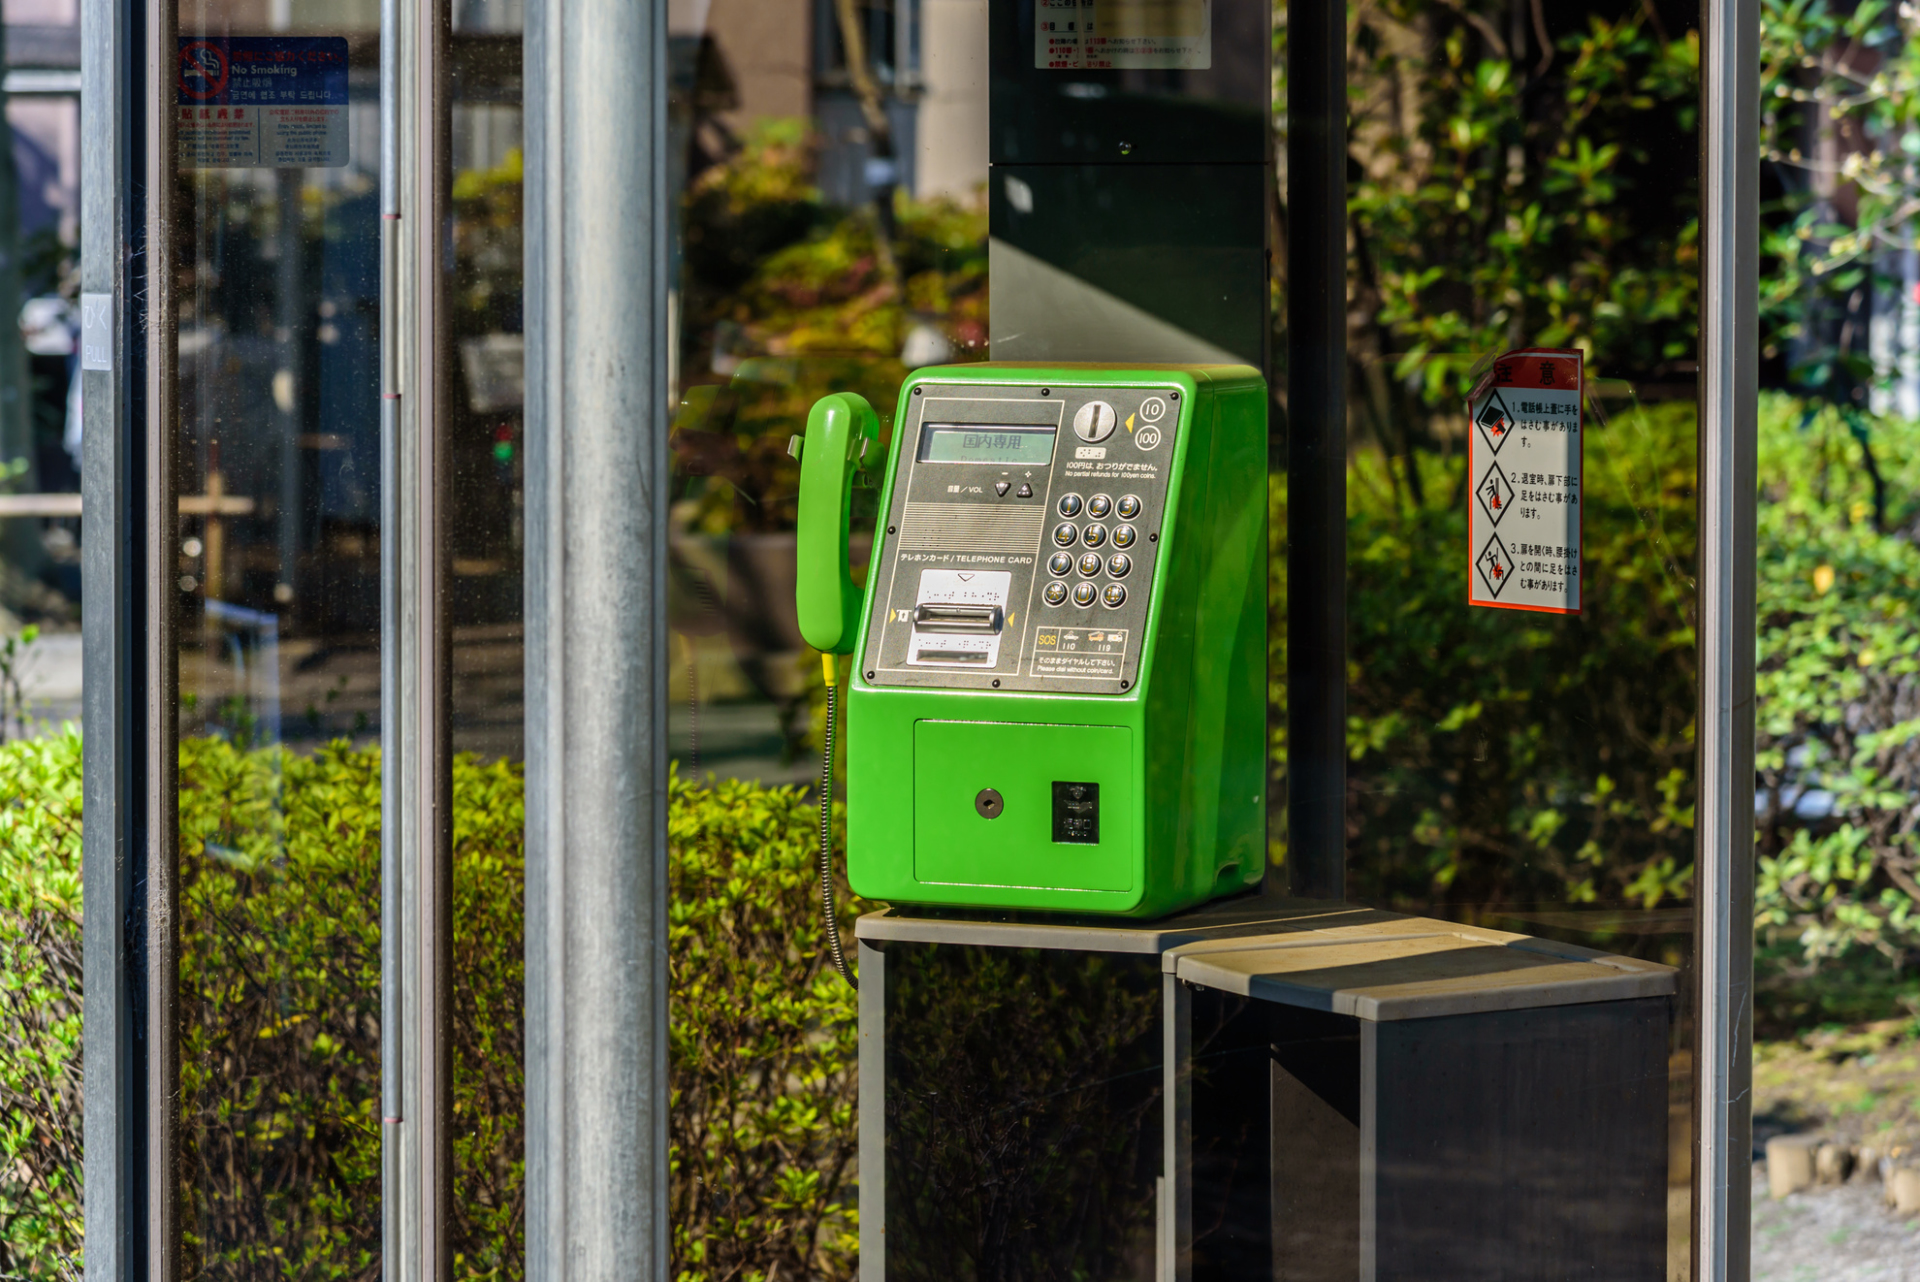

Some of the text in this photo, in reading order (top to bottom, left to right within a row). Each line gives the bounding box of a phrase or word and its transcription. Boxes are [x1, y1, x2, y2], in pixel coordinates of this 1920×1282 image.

[232, 64, 297, 77] No Smoking
[84, 305, 107, 331] ひく
[85, 345, 107, 363] PULL
[1146, 404, 1160, 415] 10
[1521, 420, 1578, 433] はさむ事がありま
[963, 434, 1022, 449] 国内専用
[1139, 432, 1158, 444] 100
[1521, 436, 1532, 448] す。
[1067, 494, 1073, 513] 1
[1093, 496, 1104, 514] 2
[1520, 490, 1578, 505] 足をはさむ事があ
[1122, 497, 1133, 514] 3
[1520, 507, 1541, 520] ります。
[1058, 524, 1071, 542] 4
[1088, 525, 1100, 543] 5
[1116, 526, 1128, 544] 6
[901, 554, 950, 562] テレホンカード
[956, 555, 1005, 563] TELEPHONE
[1007, 556, 1033, 564] CARD
[1056, 554, 1066, 572] 7
[1082, 556, 1094, 572] 8
[1113, 556, 1123, 573] 9
[1520, 561, 1578, 576] との間に足をはさ
[1078, 585, 1090, 602] 0
[1520, 579, 1568, 594] む事があります。
[1038, 635, 1057, 645] SOS
[1062, 643, 1111, 652] 110 119
